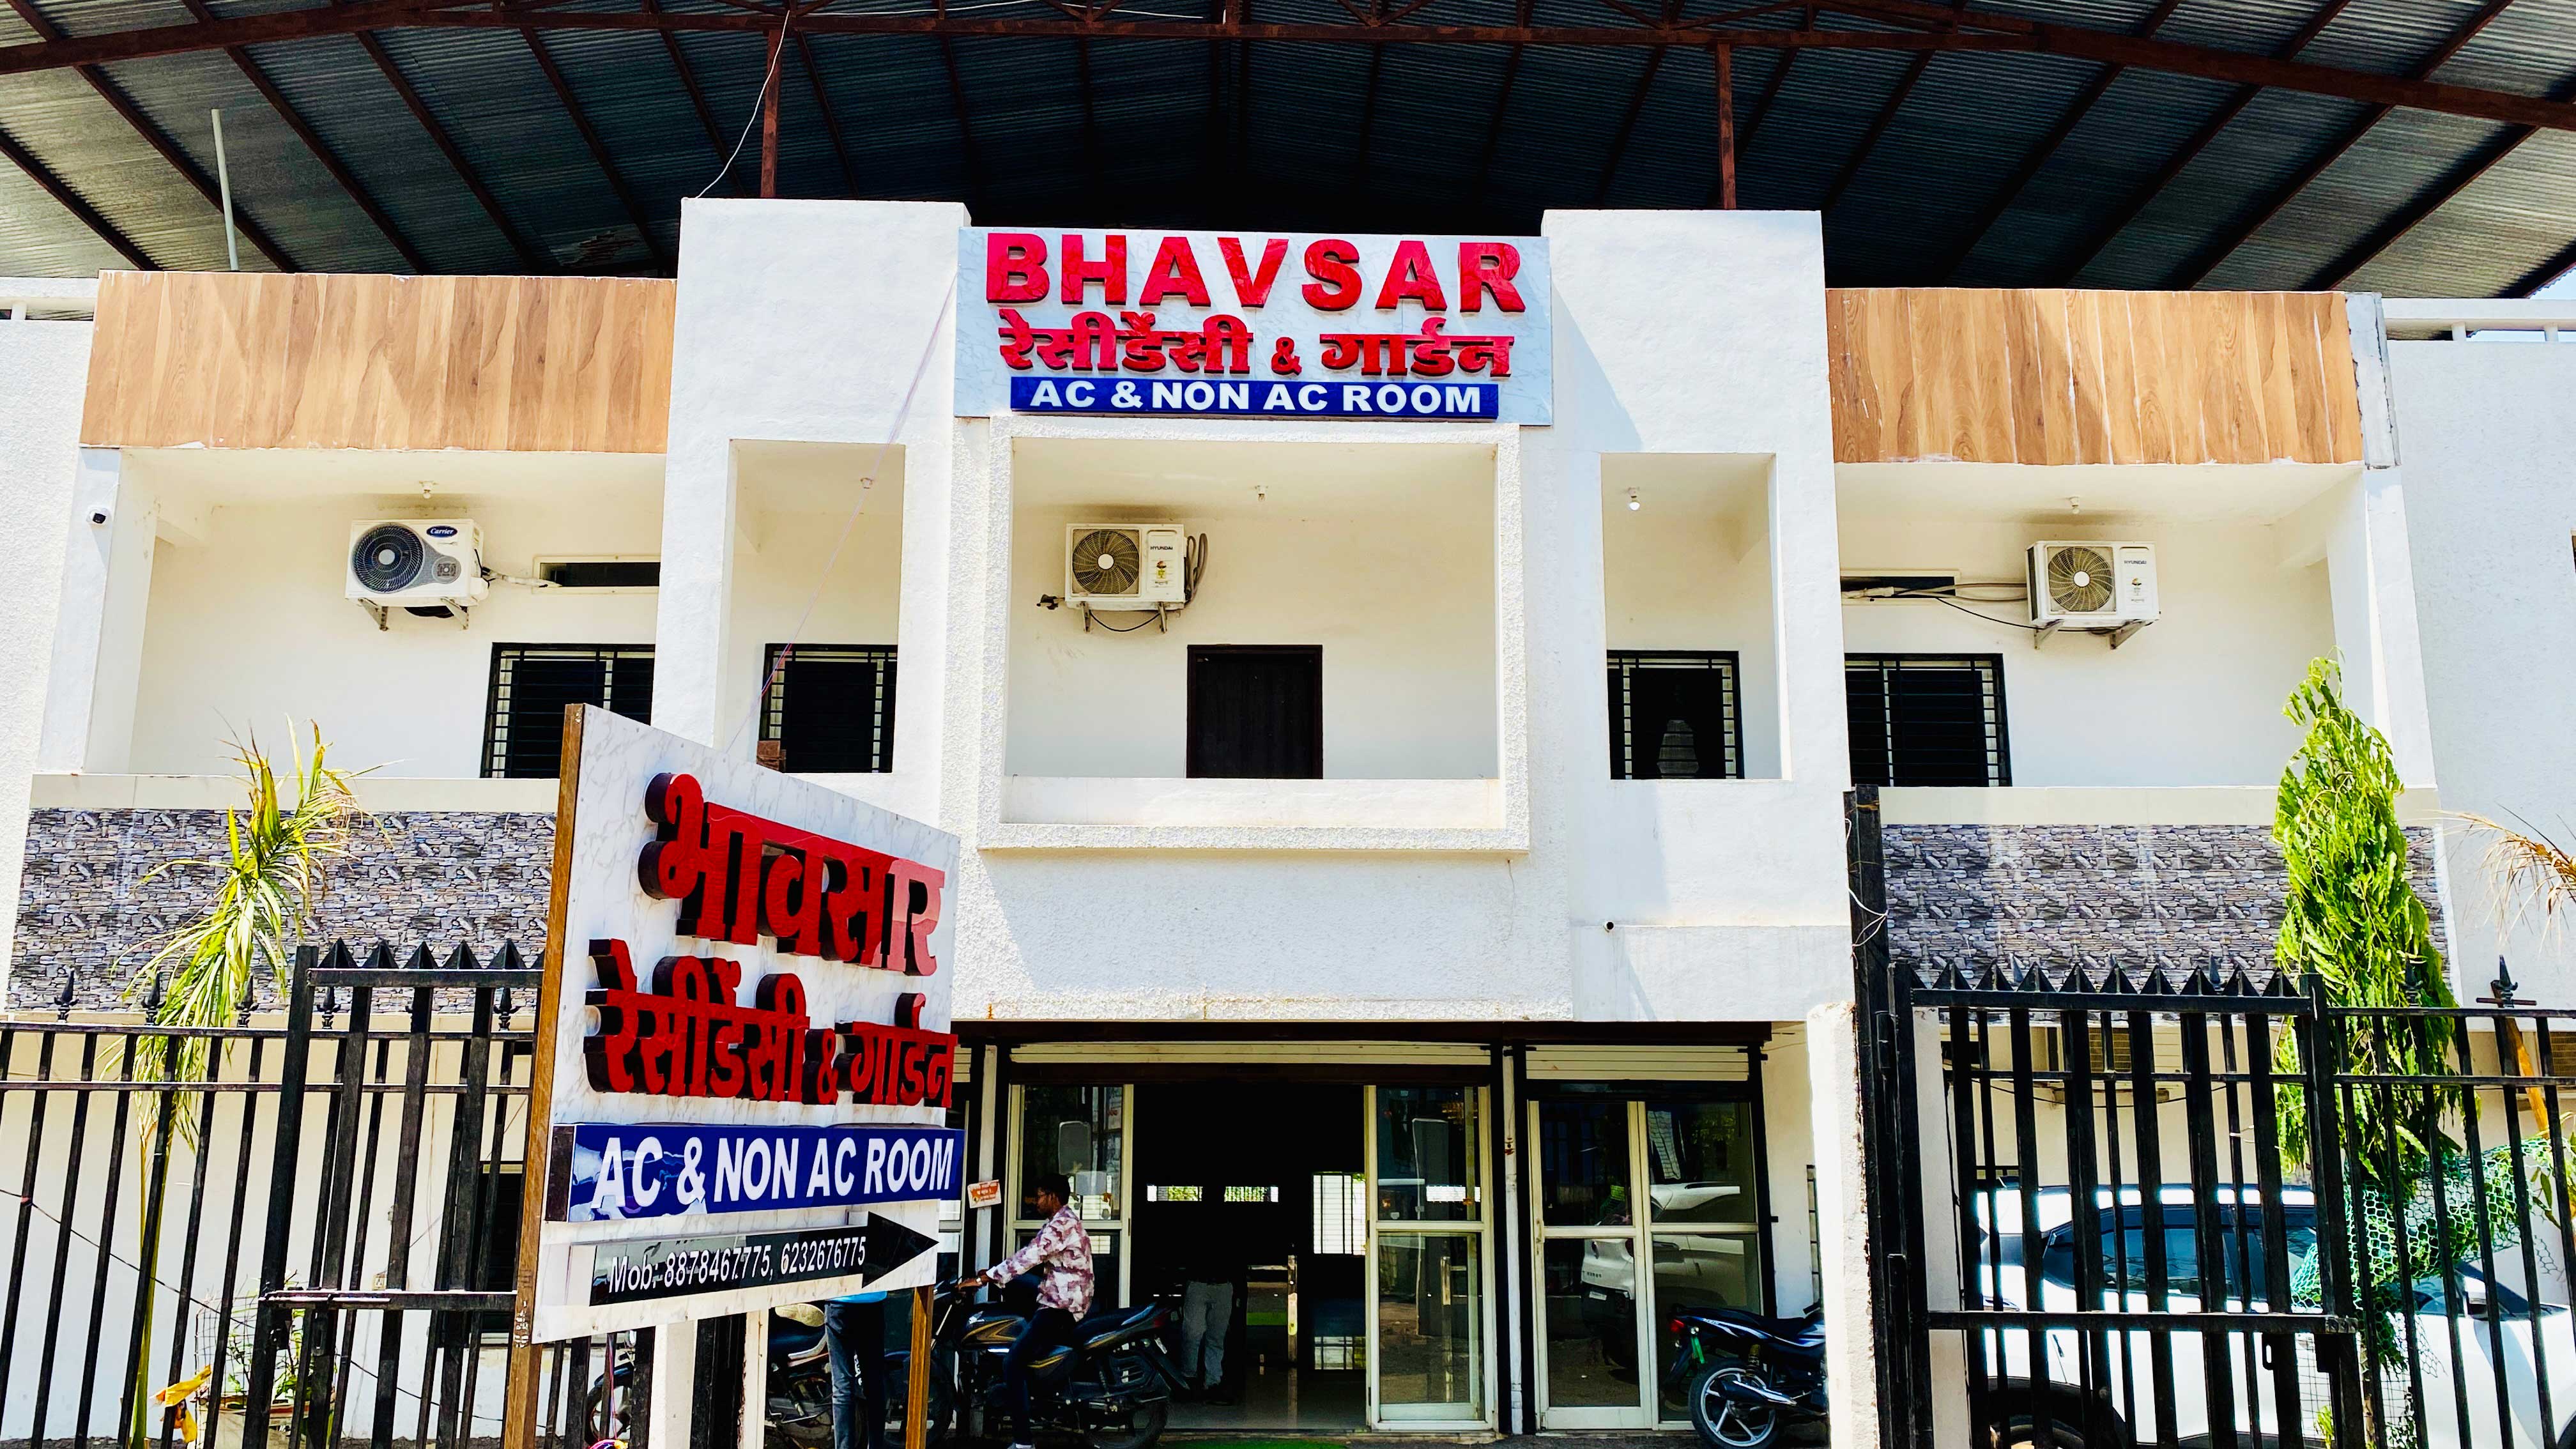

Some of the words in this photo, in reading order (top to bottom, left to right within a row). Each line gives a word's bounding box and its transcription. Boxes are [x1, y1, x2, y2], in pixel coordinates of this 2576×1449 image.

[986, 232, 1527, 312] BHAVSAR
[998, 309, 1254, 374] रेसीडेंसी
[1271, 337, 1302, 376] &
[1319, 317, 1515, 377] गार्डन
[1030, 380, 1095, 408] AC
[1110, 381, 1144, 408] &
[1152, 381, 1249, 410] NON
[1263, 384, 1328, 411] AC
[1343, 384, 1480, 413] ROOM
[640, 772, 945, 976] भावसार
[586, 939, 810, 1102] रेसीडेंसी
[807, 1028, 838, 1105] &
[837, 993, 958, 1108] गार्डन
[591, 1137, 664, 1209] AC
[676, 1135, 706, 1205] &
[714, 1137, 799, 1202] NON
[806, 1137, 857, 1197] AC
[865, 1137, 954, 1194] ROOM
[780, 1236, 866, 1275] 6232676775
